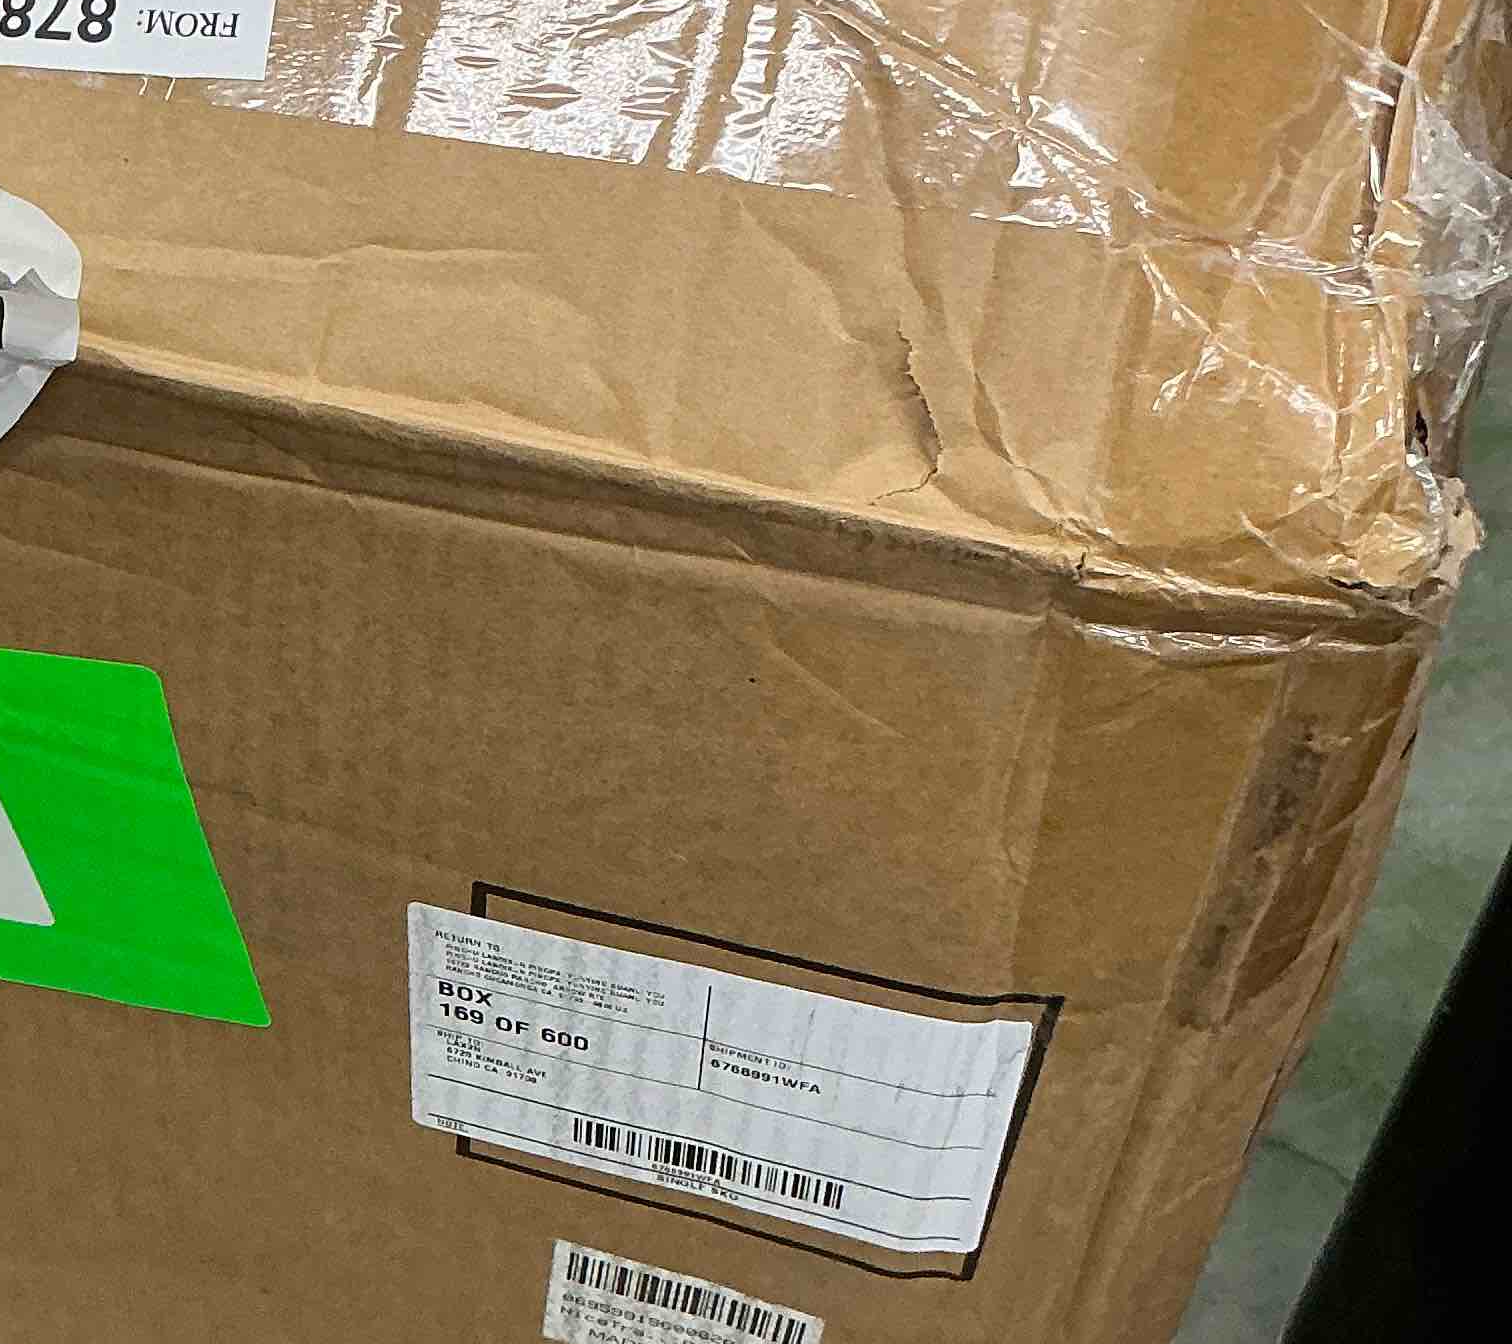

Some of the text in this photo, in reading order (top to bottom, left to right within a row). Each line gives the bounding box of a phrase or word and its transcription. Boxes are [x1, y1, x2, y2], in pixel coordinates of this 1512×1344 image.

[135, 9, 241, 38] FROM:
[438, 980, 494, 1007] BOX
[439, 1003, 589, 1051] 169 OF 600
